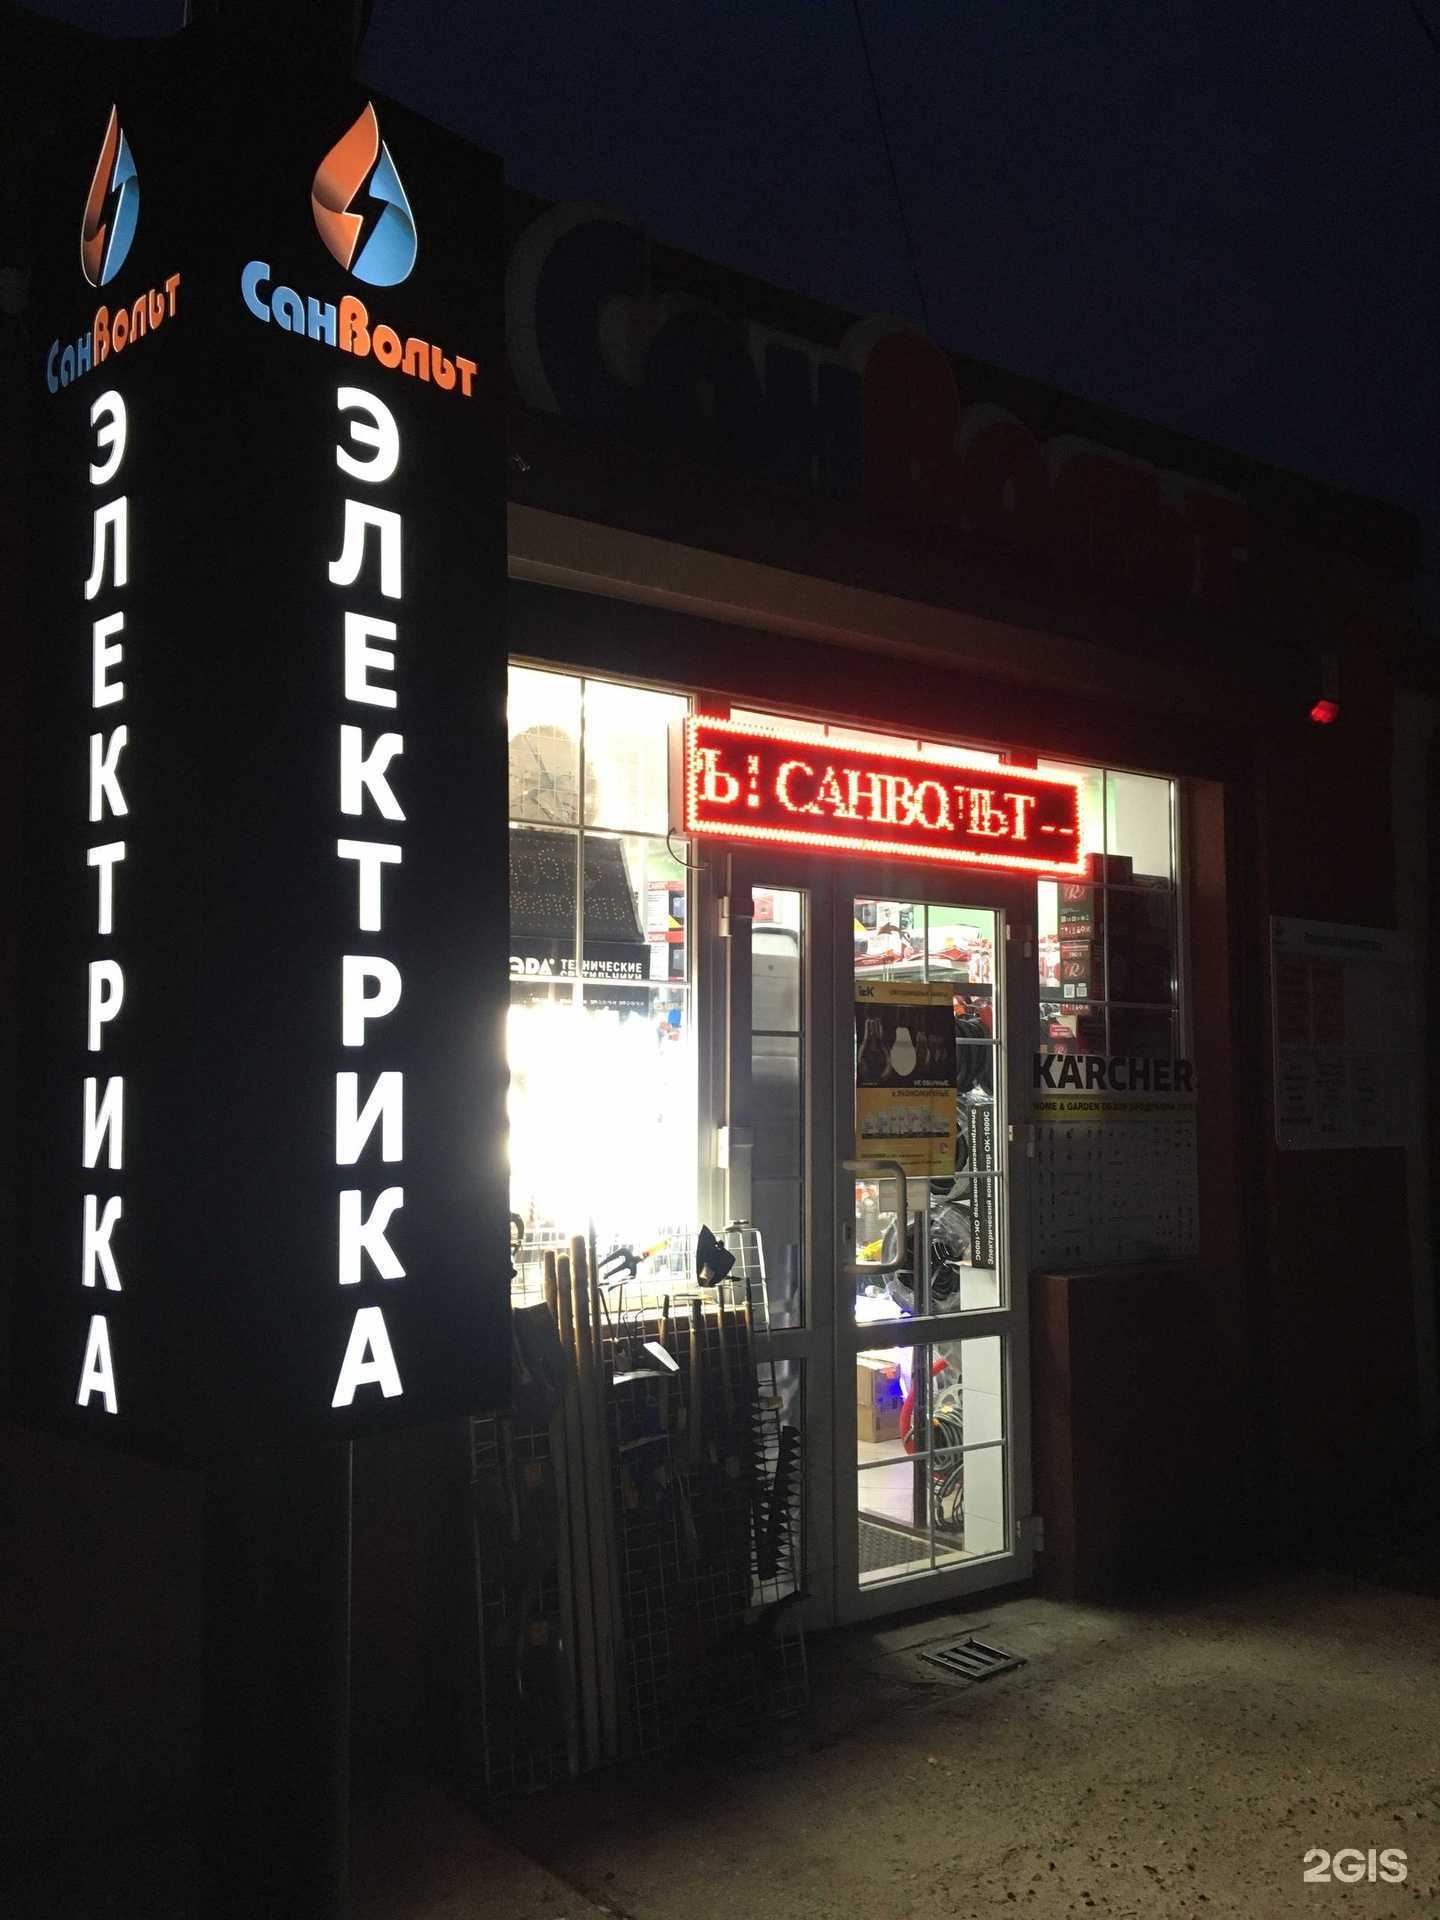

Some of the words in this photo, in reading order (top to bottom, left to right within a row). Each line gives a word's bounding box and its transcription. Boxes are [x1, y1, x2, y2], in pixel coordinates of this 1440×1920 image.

[46, 272, 180, 394] СанВольт
[240, 261, 478, 397] СанВольт
[75, 390, 129, 1414] ЭЛЕКТРИКА
[328, 387, 406, 1408] ЭЛЕКТРИКА
[1033, 1052, 1194, 1092] KÄRCHER
